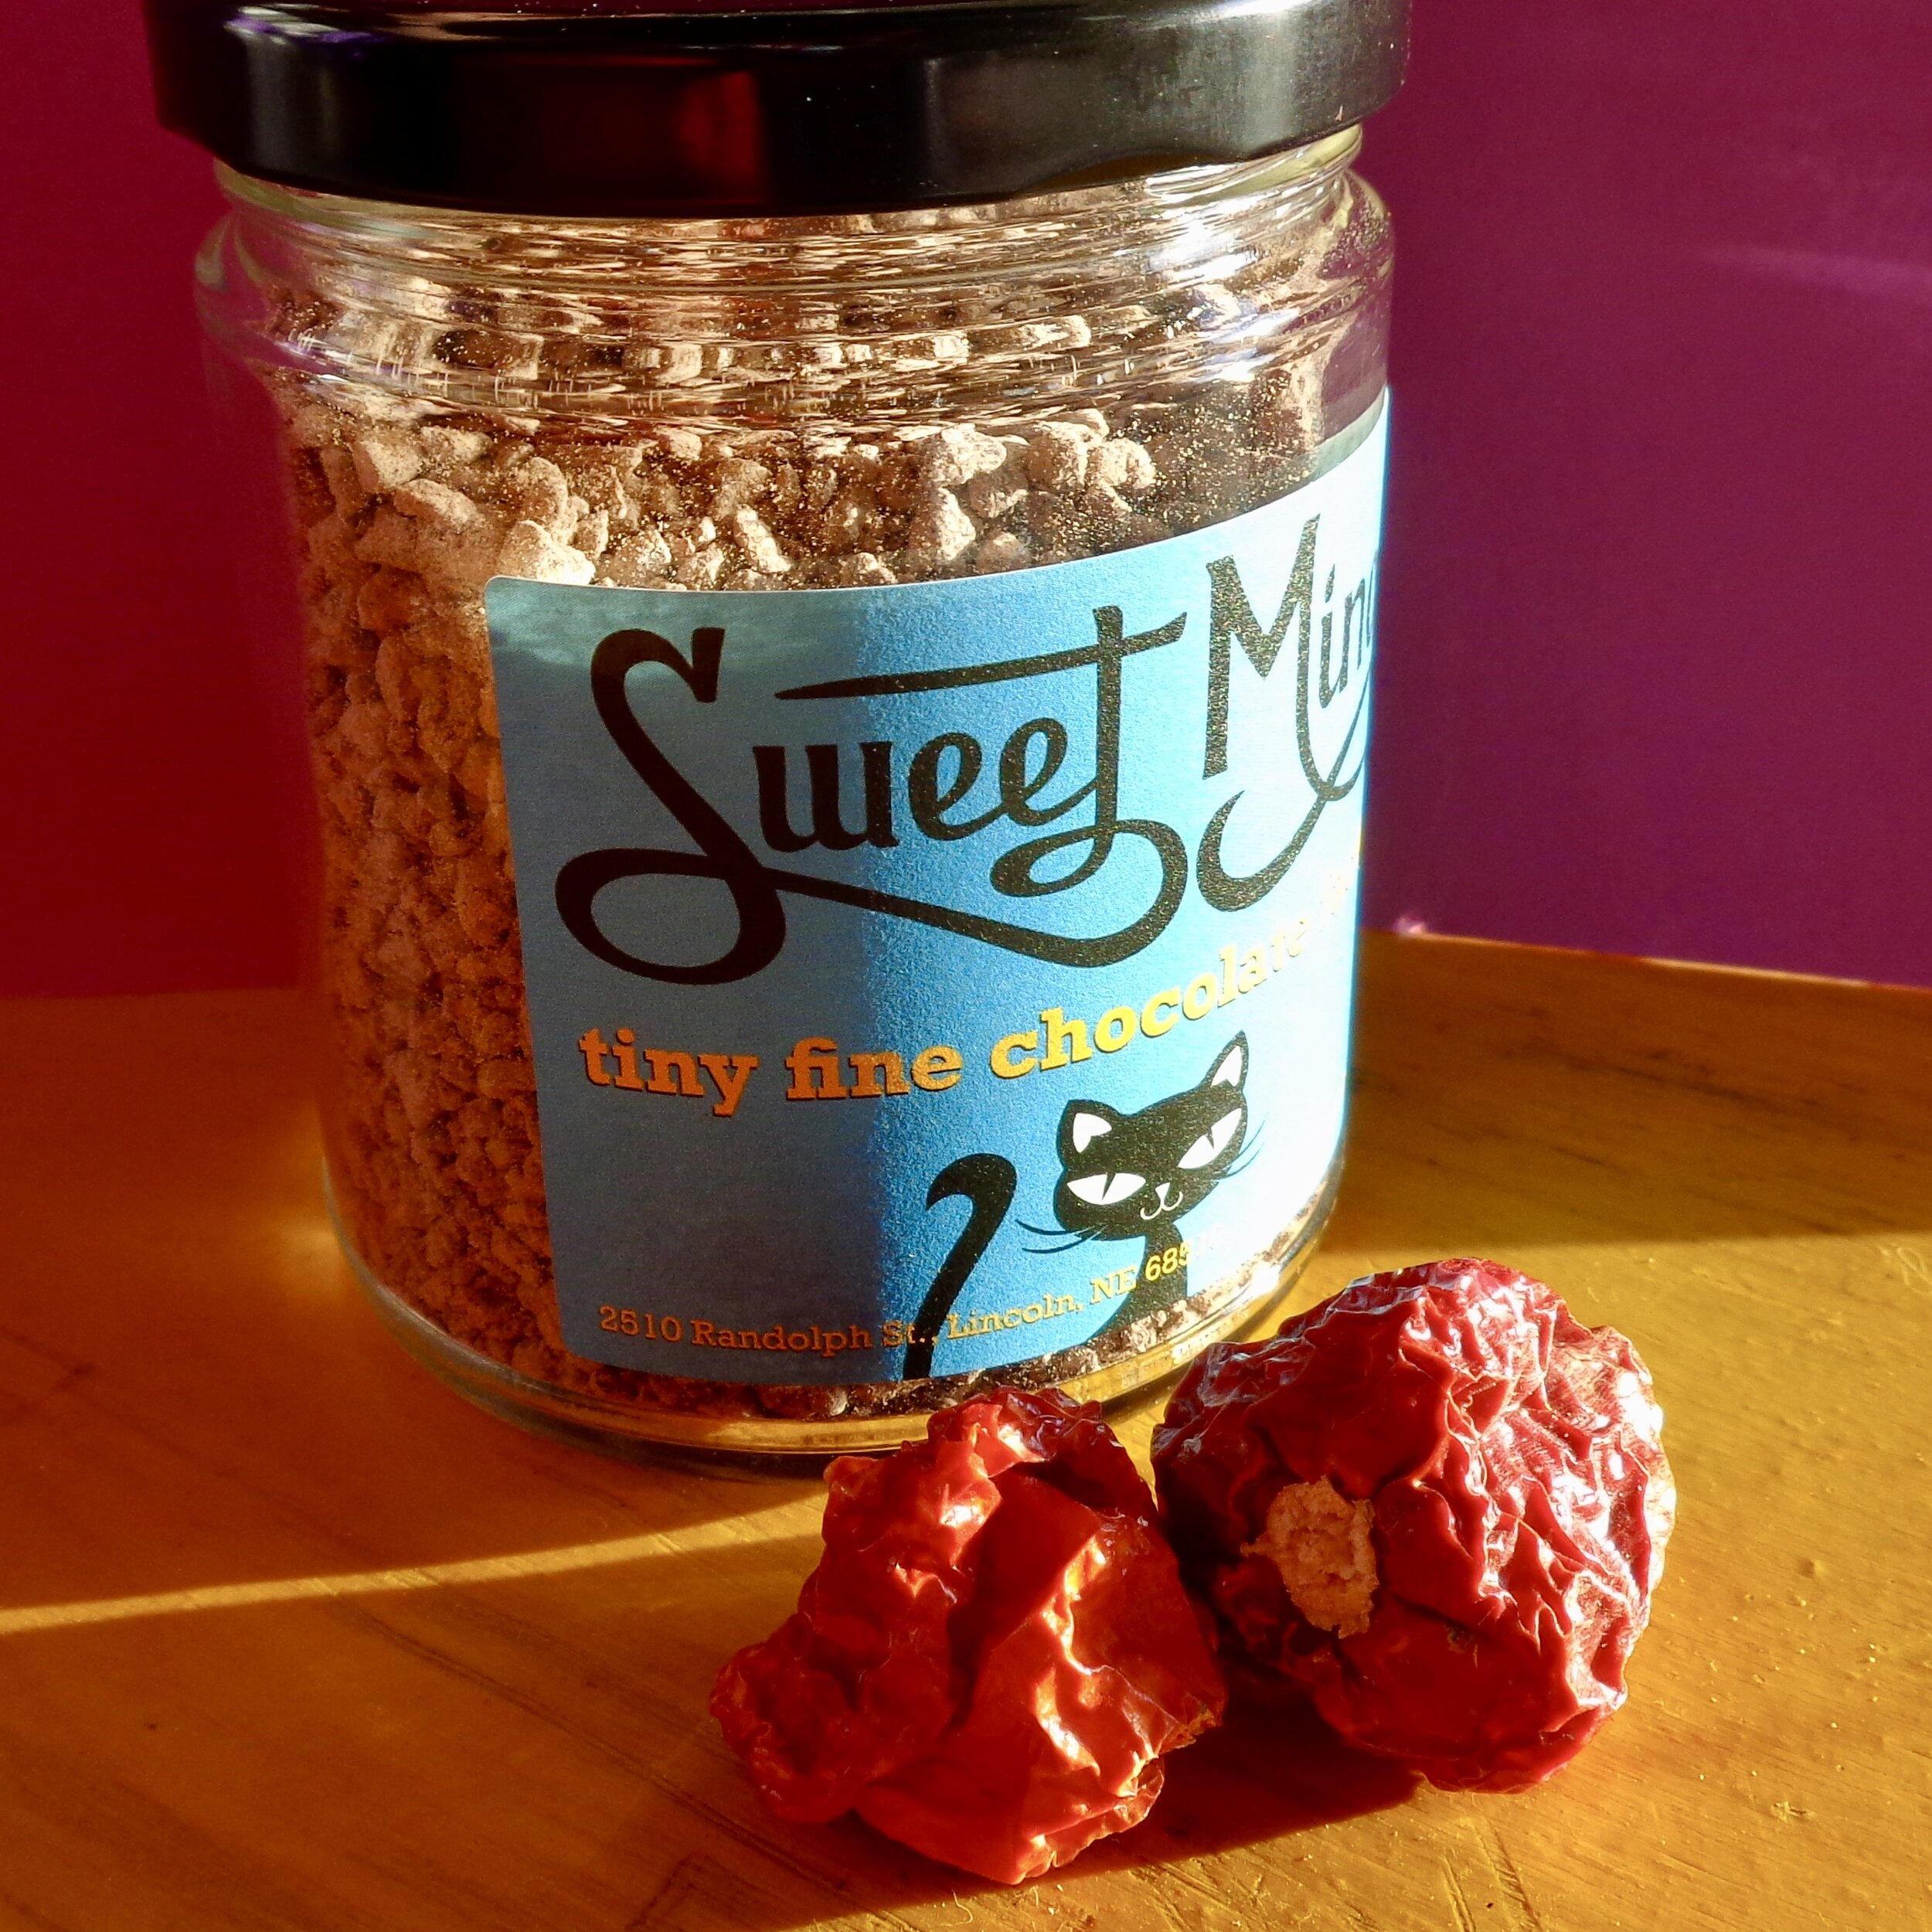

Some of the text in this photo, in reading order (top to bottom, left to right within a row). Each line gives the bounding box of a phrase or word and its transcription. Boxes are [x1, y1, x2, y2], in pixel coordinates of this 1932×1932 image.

[554, 512, 1378, 985] Sweet Min
[578, 917, 1309, 1117] tiny fine chocolate
[598, 1304, 683, 1343] 2510
[690, 1319, 873, 1357] Randolph
[946, 1292, 1085, 1339] Lincoln,
[1090, 1264, 1138, 1304] NE
